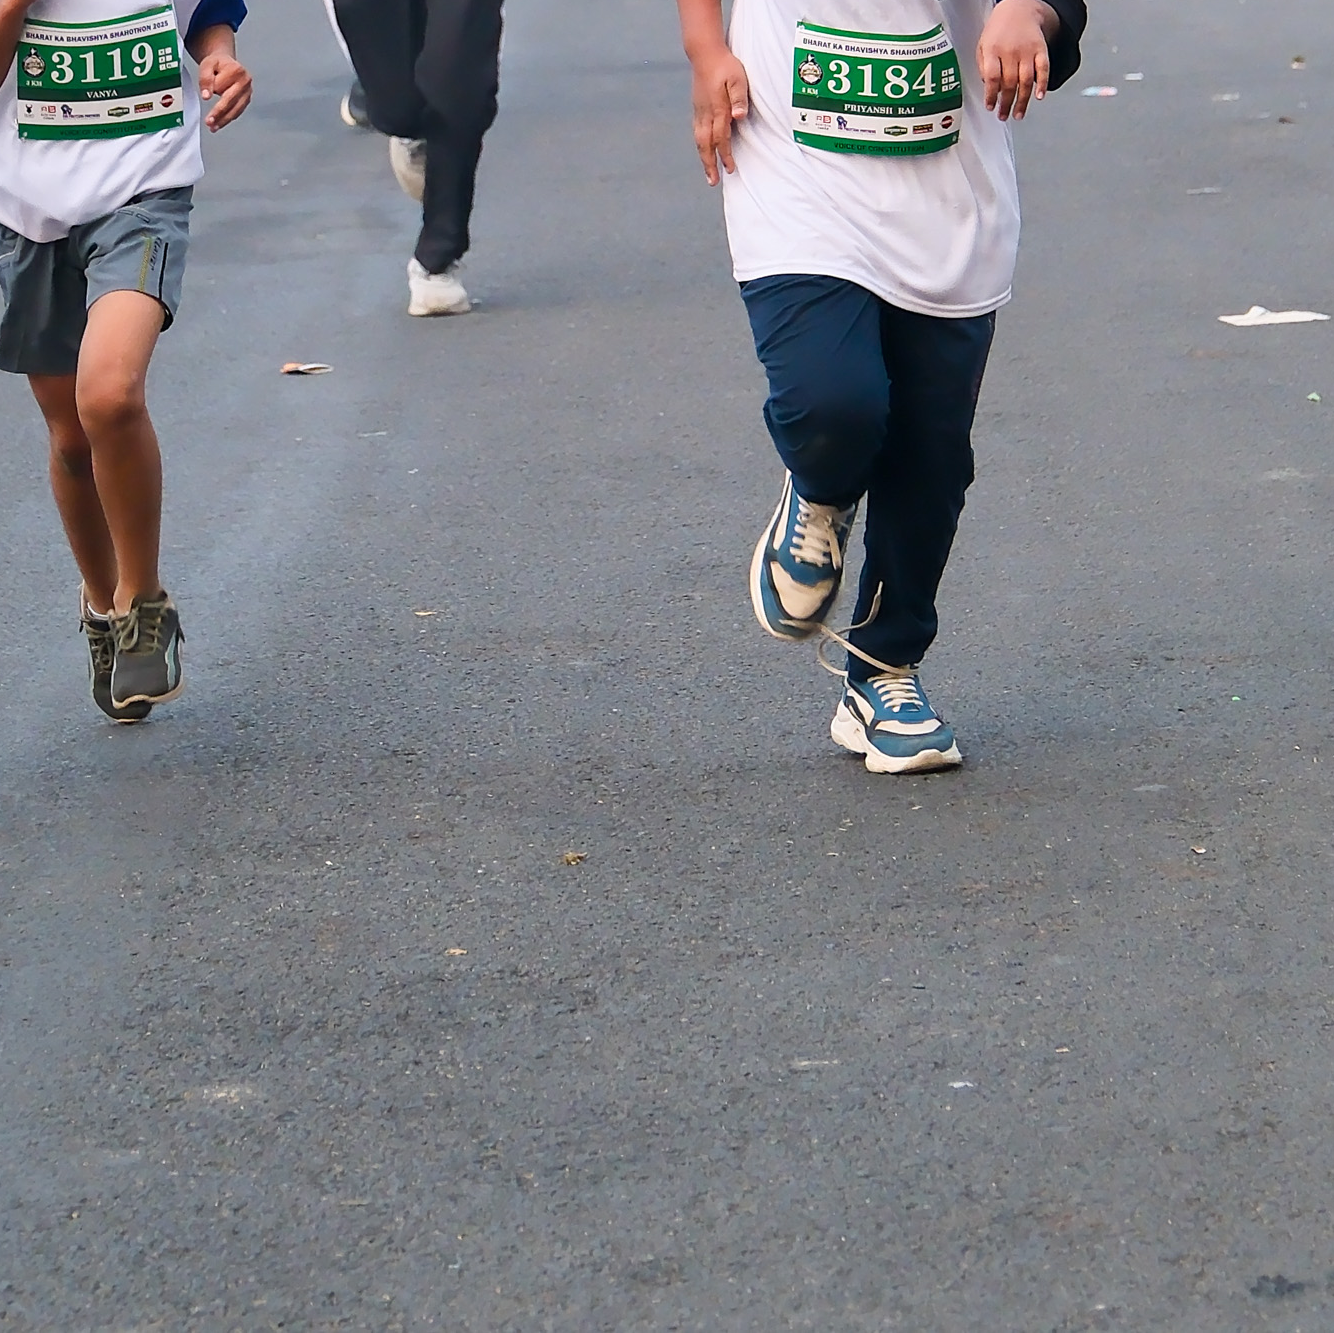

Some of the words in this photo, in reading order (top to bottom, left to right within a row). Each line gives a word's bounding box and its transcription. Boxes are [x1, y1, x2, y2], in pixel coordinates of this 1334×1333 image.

[25, 31, 52, 41] BHARAT
[66, 34, 108, 43] BHAVISHYA
[152, 19, 169, 30] 2025
[803, 37, 832, 49] BHARAT
[832, 42, 843, 50] KA
[844, 44, 888, 56] BHAVISHYA
[50, 42, 154, 84] 3119
[827, 59, 937, 99] 3184
[86, 88, 118, 99] VANYA
[844, 103, 893, 115] PRIYANSH
[897, 105, 916, 115] RAI
